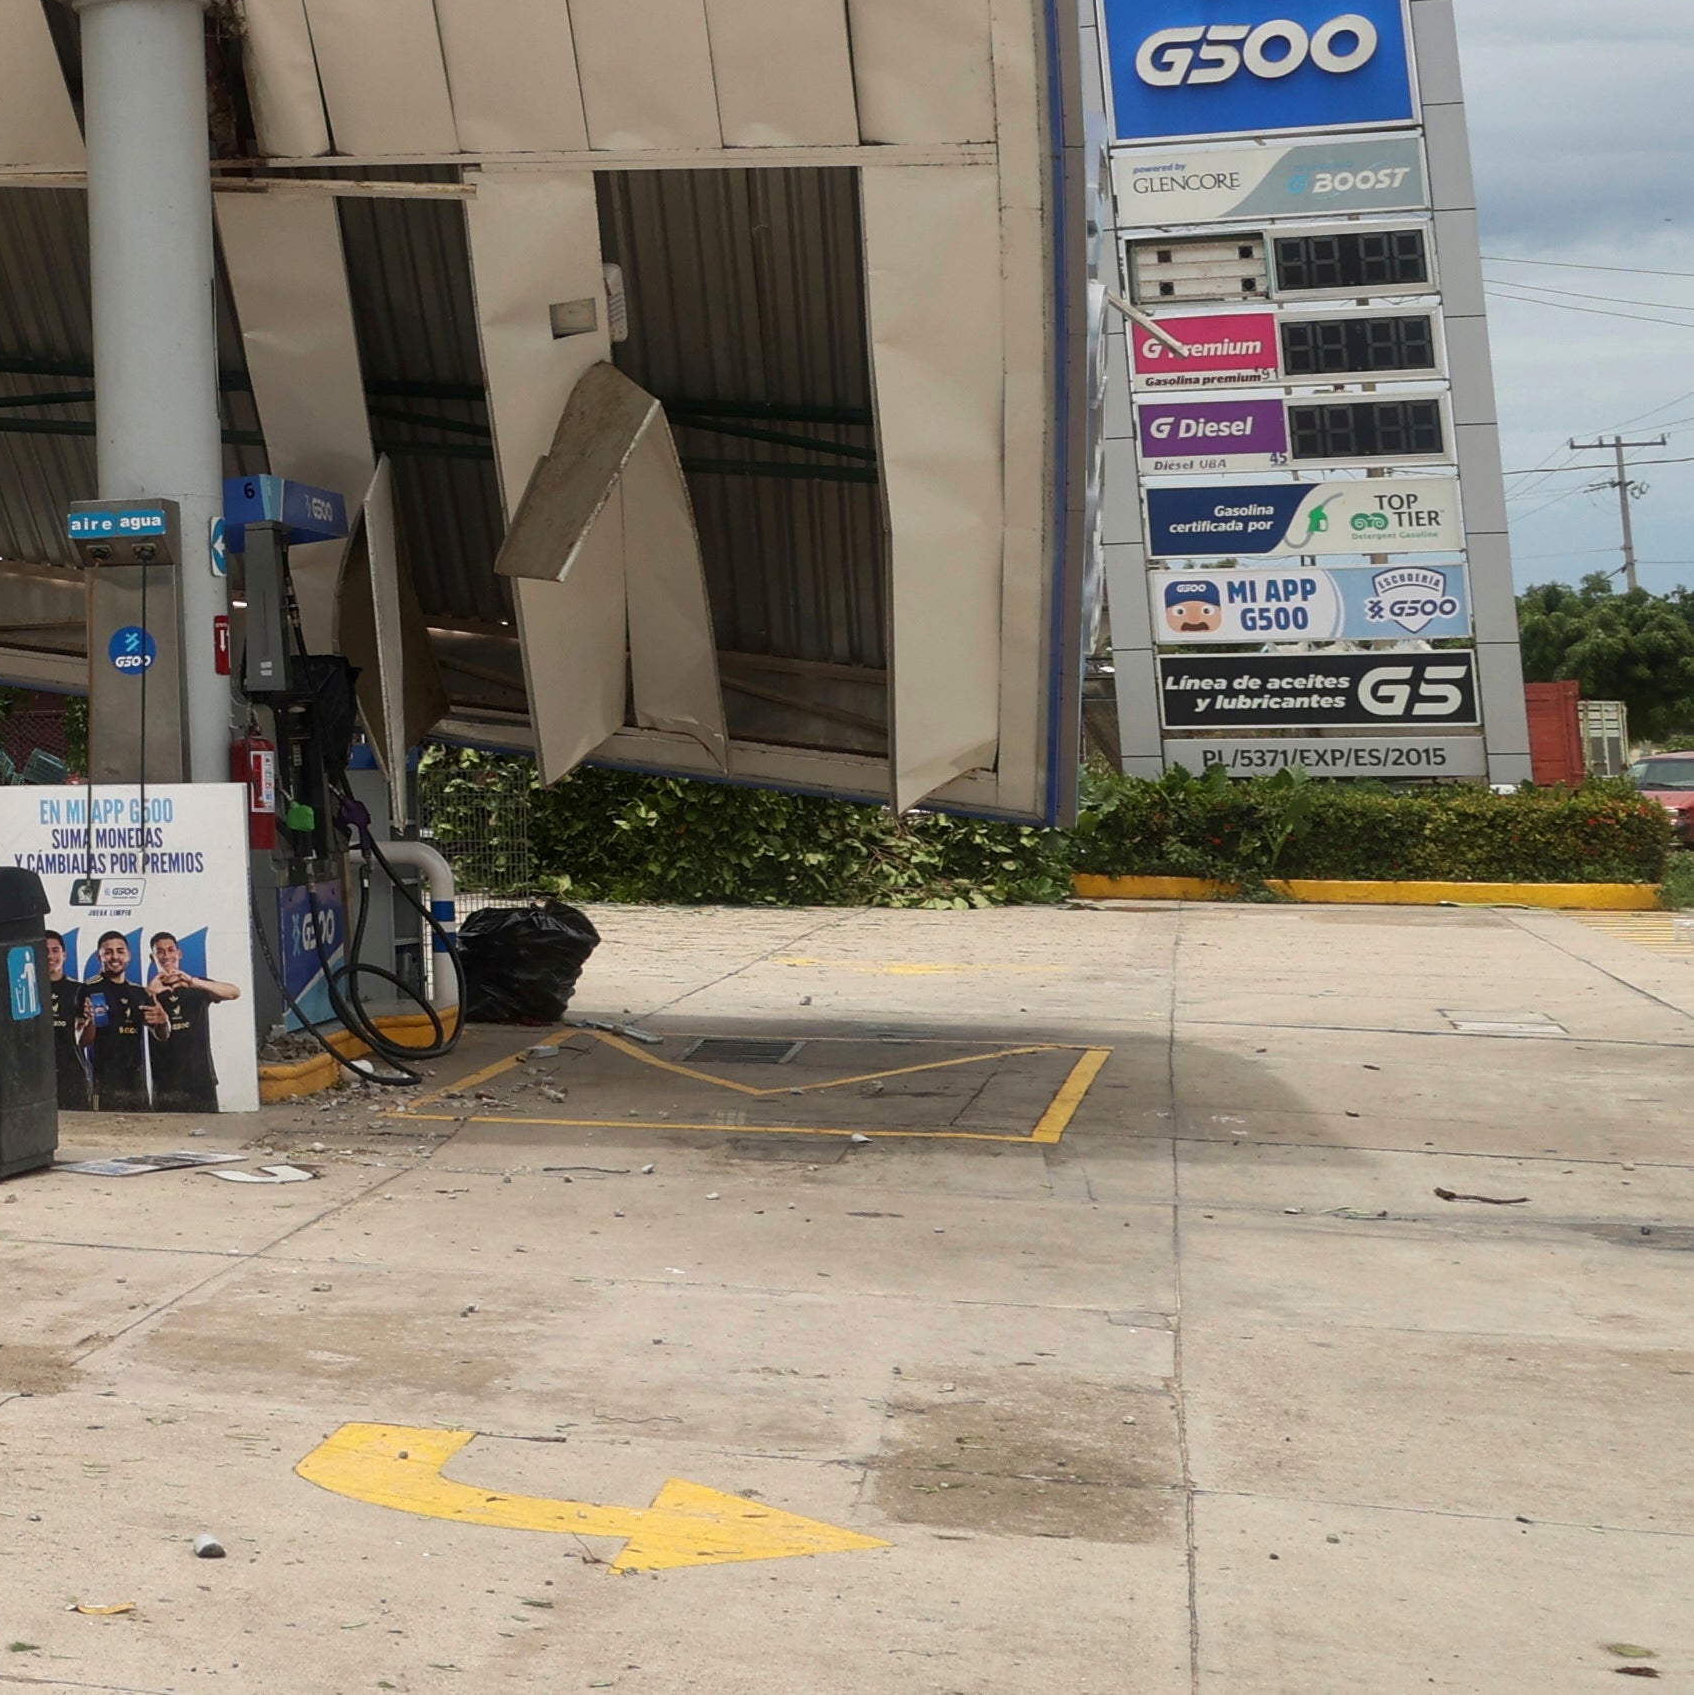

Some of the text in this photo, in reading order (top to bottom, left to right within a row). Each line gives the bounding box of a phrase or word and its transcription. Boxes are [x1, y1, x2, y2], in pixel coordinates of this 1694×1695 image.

[1135, 14, 1377, 86] G500
[1132, 163, 1187, 174] powered by
[1133, 172, 1240, 194] GLENCORE
[1312, 167, 1411, 193] BOOST
[1168, 338, 1262, 358] remium
[1145, 376, 1200, 387] Gasolina
[1202, 372, 1261, 386] premium
[1150, 416, 1253, 439] G Diesel
[1199, 459, 1227, 469] UBA
[244, 482, 255, 499] 6
[1214, 504, 1274, 518] Gasolina
[1373, 494, 1418, 511] TOP
[71, 515, 162, 531] aire agua
[1169, 519, 1274, 533] certificada por
[1392, 510, 1441, 528] TIER
[1176, 583, 1206, 593] G500
[1227, 578, 1317, 604] MI APP
[1389, 600, 1456, 617] G500
[1240, 606, 1309, 631] G500
[115, 655, 151, 667] G500
[1165, 674, 1351, 691] Línea de aceites
[1358, 666, 1467, 716] G5
[1194, 694, 1346, 712] y lubricantes
[40, 798, 173, 825] EN MI APP G500
[52, 827, 163, 849] SUMA MONEDAS
[27, 850, 106, 874] CÁMBIALAS
[111, 853, 137, 873] POR
[143, 852, 204, 874] PREMIOS
